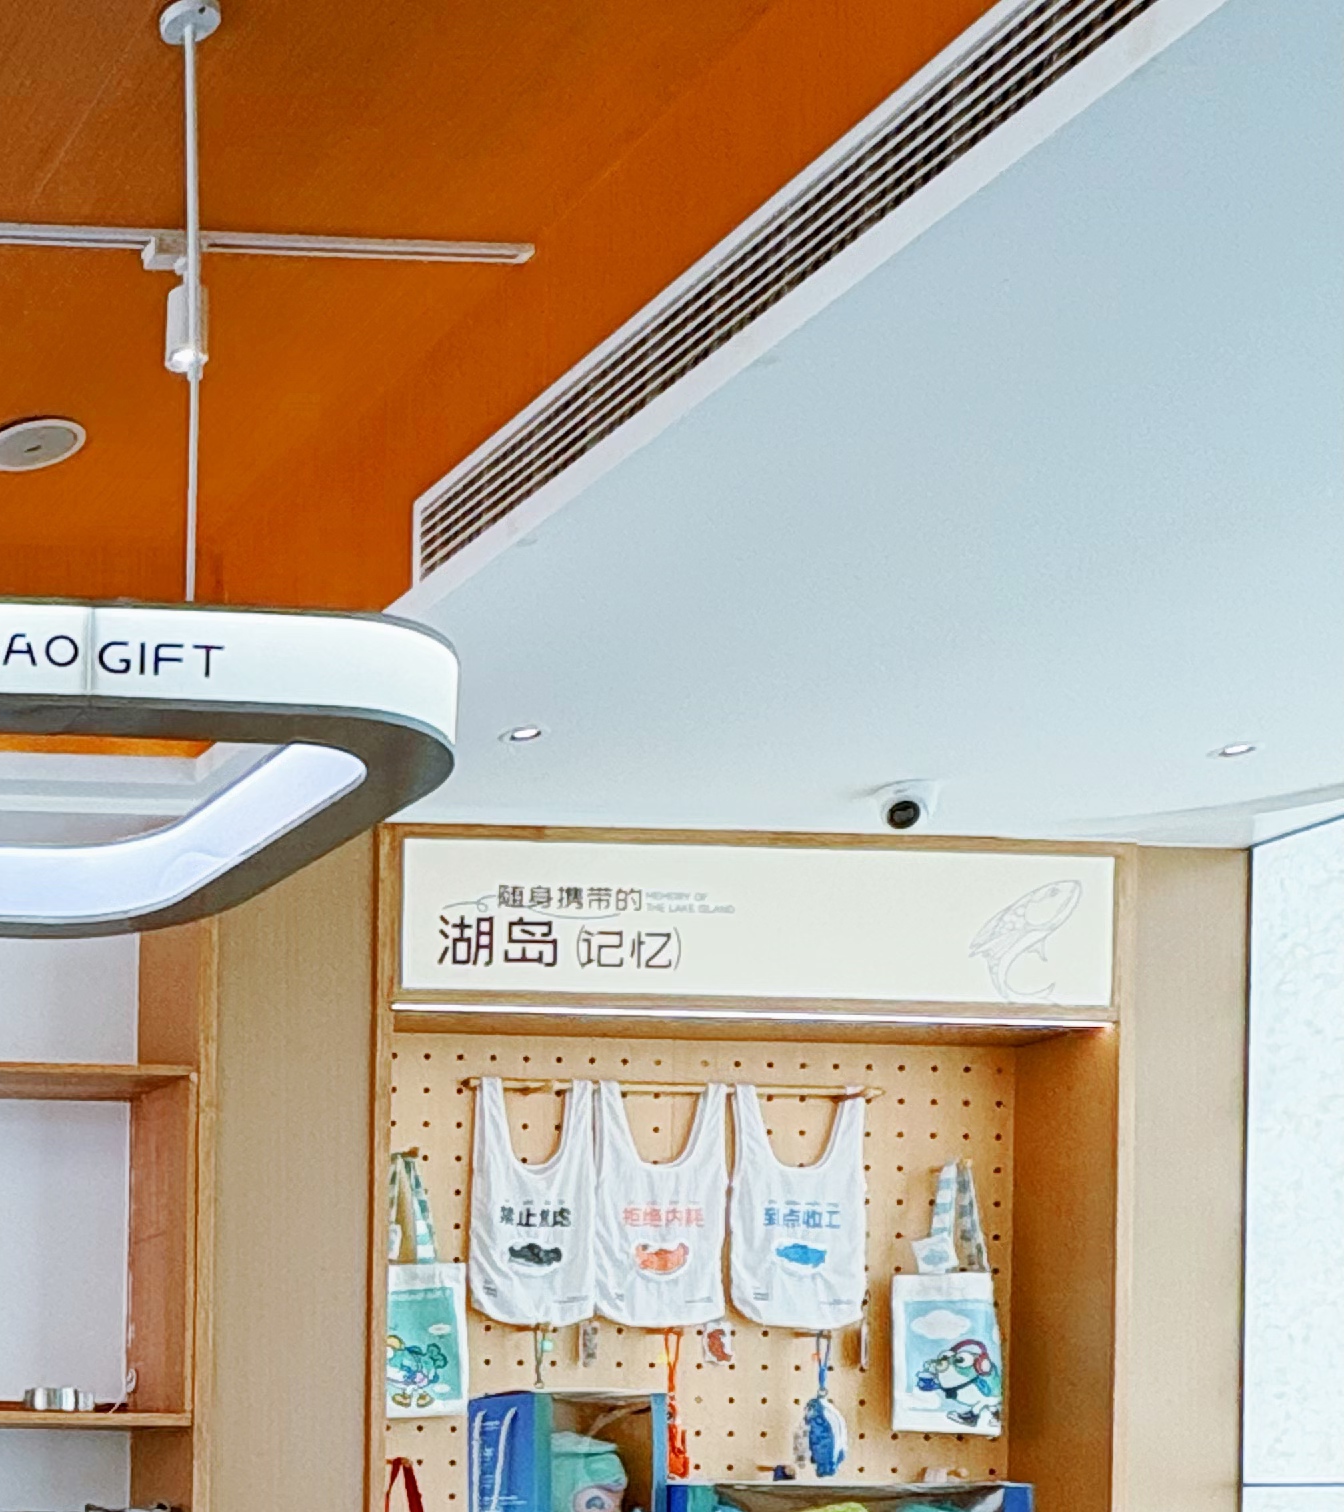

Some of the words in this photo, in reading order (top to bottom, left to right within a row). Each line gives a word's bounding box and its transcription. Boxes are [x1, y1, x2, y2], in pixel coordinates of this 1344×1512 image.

[96, 640, 225, 677] GIFT
[496, 884, 643, 912] 随身携带的
[622, 1207, 706, 1228] 拒绝内耗
[763, 1207, 841, 1228] 到点收工
